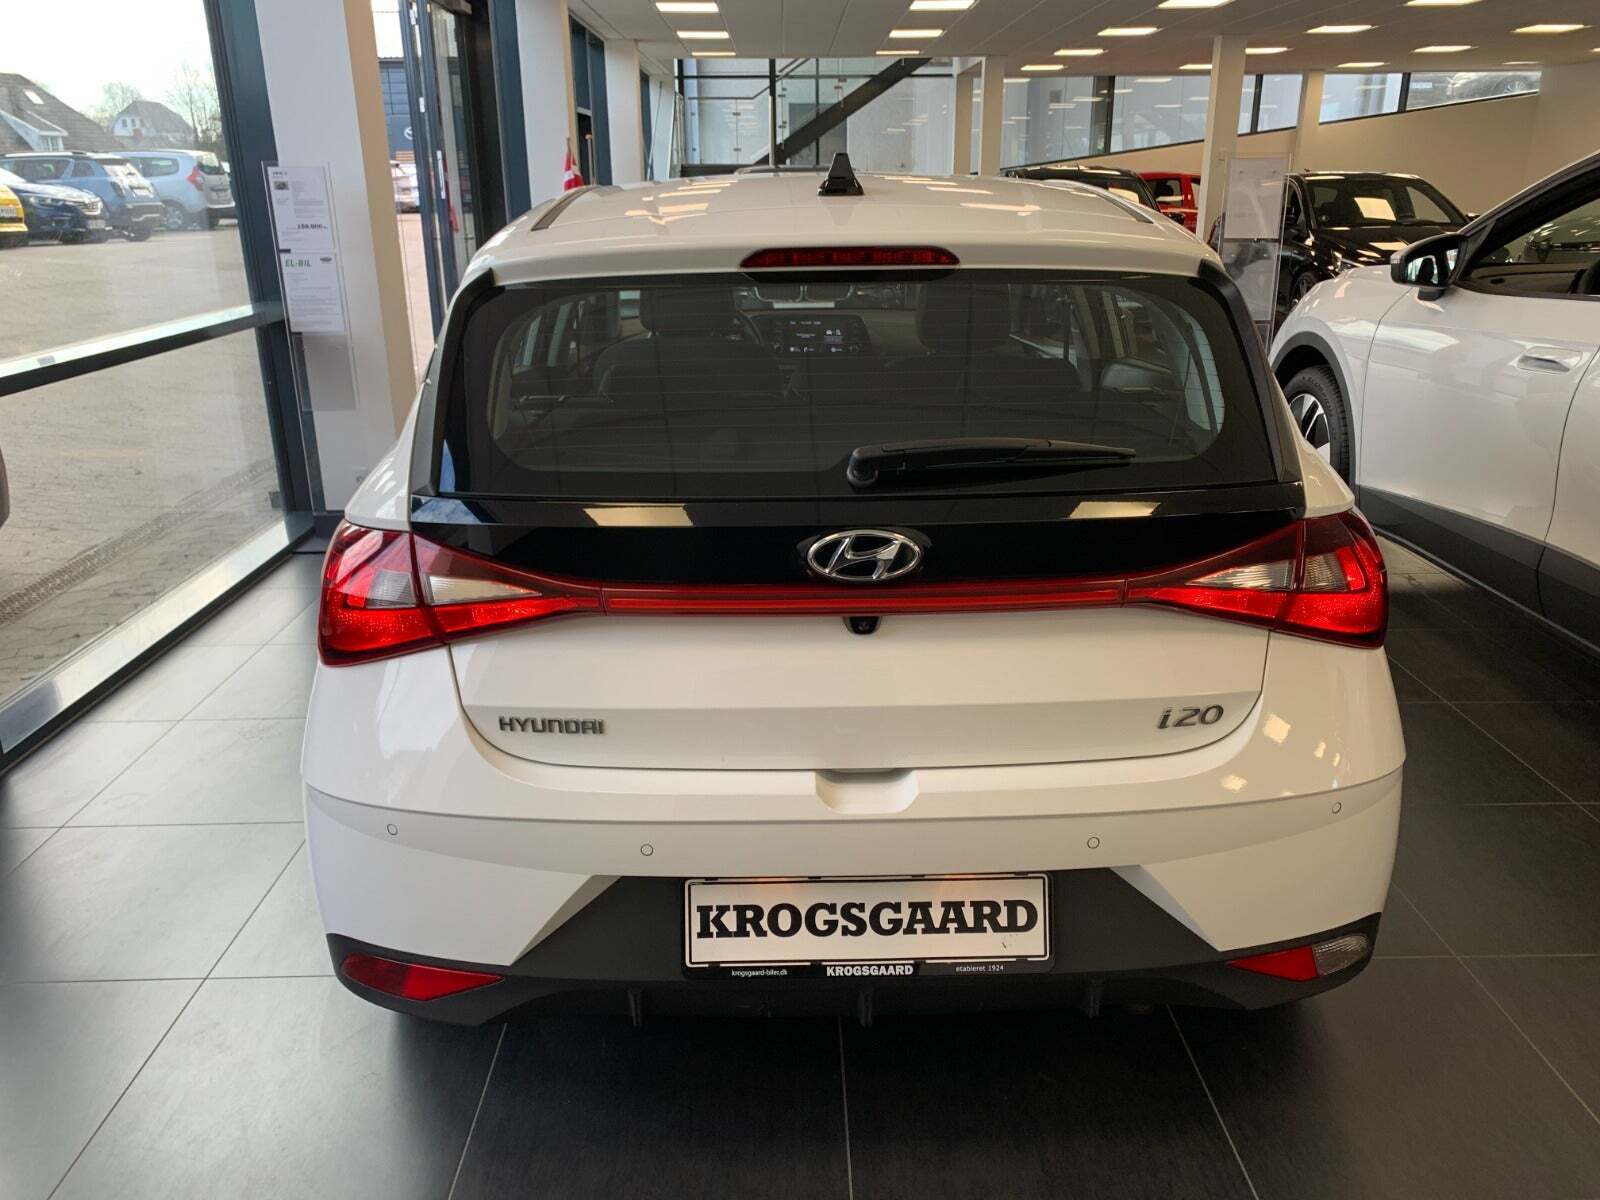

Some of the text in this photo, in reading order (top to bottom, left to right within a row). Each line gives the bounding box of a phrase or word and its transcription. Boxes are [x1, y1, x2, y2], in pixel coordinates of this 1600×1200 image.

[1157, 704, 1224, 729] i20
[498, 715, 606, 734] HYUNDAI
[696, 899, 1039, 939] KROGSGAARD
[731, 968, 788, 978] krogsgaard-biler.dk
[826, 965, 914, 977] KROGSGAARD
[988, 964, 1004, 972] 1924
